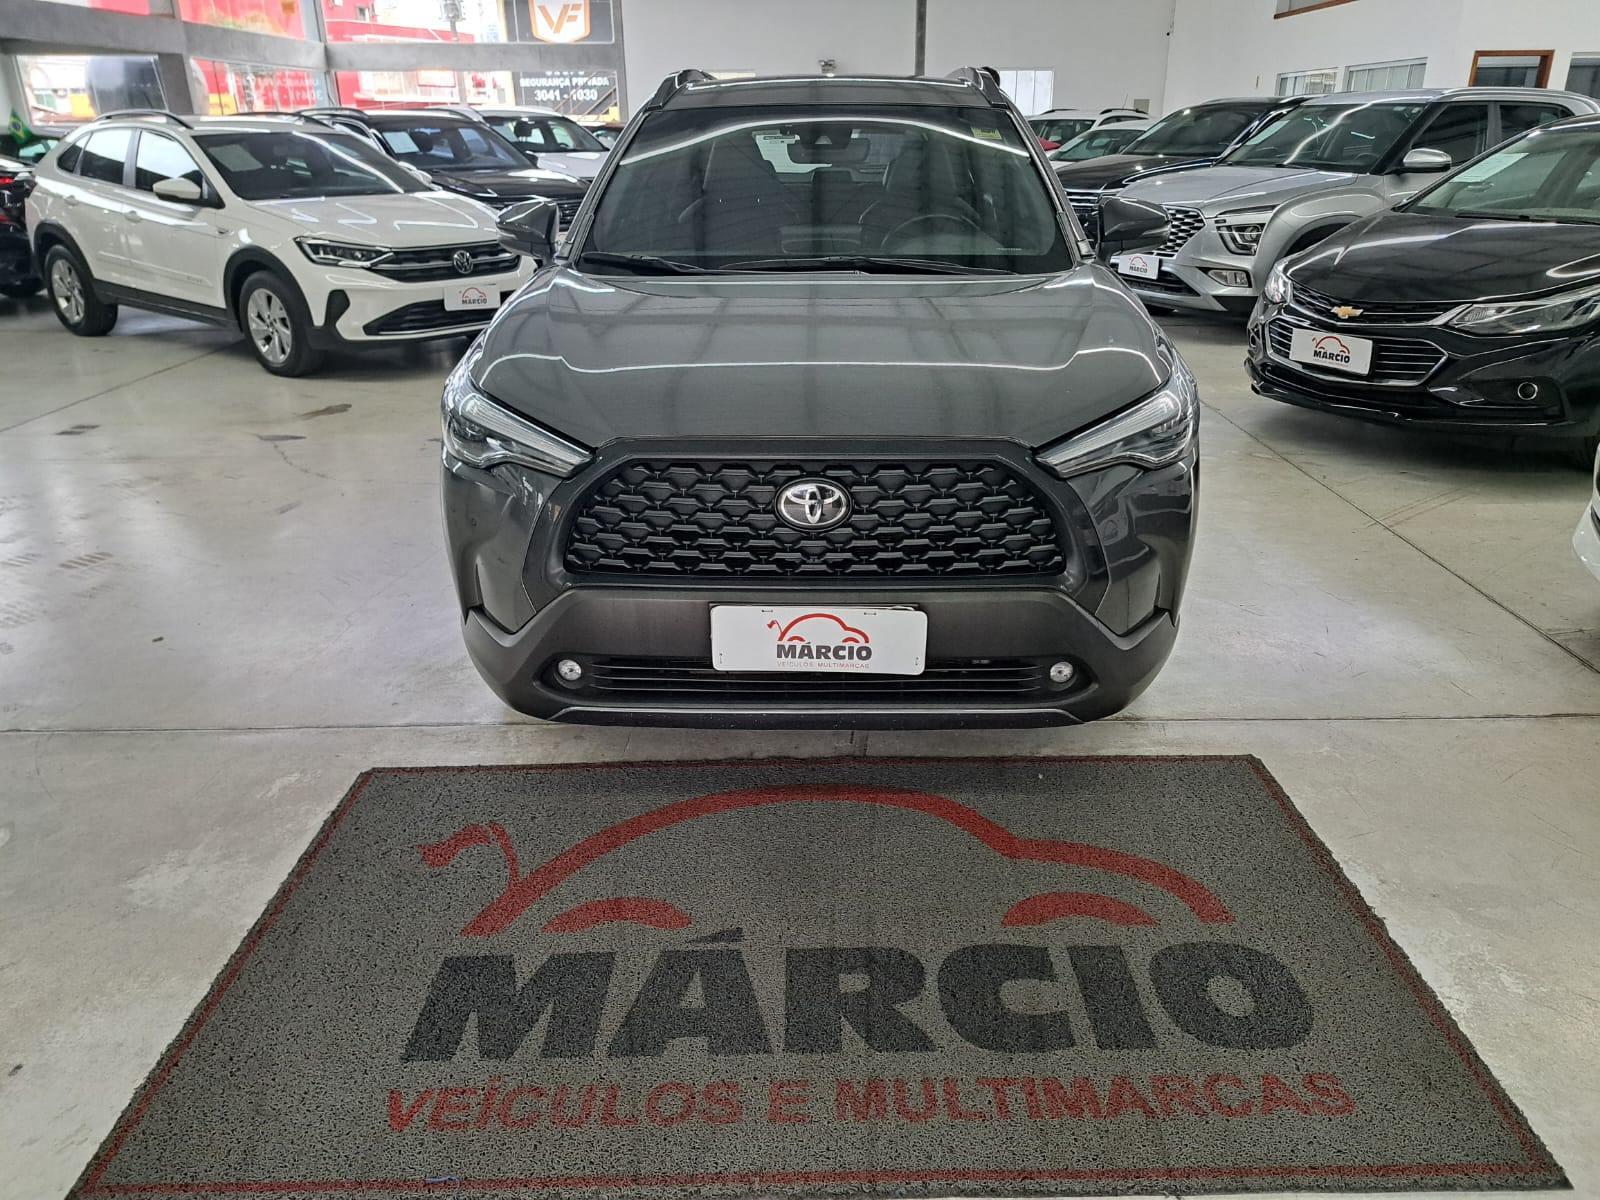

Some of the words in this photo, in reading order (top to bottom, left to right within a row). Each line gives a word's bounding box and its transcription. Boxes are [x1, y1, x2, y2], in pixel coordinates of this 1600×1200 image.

[520, 77, 570, 88] SEGURANÇA
[534, 89, 560, 101] 3041
[776, 642, 872, 661] MÁRCIO
[402, 928, 1313, 1062] MÁRCIO
[387, 1075, 742, 1132] VEÍCULOS
[766, 1079, 809, 1123] E
[834, 1073, 1355, 1123] MULTIMARCAS
